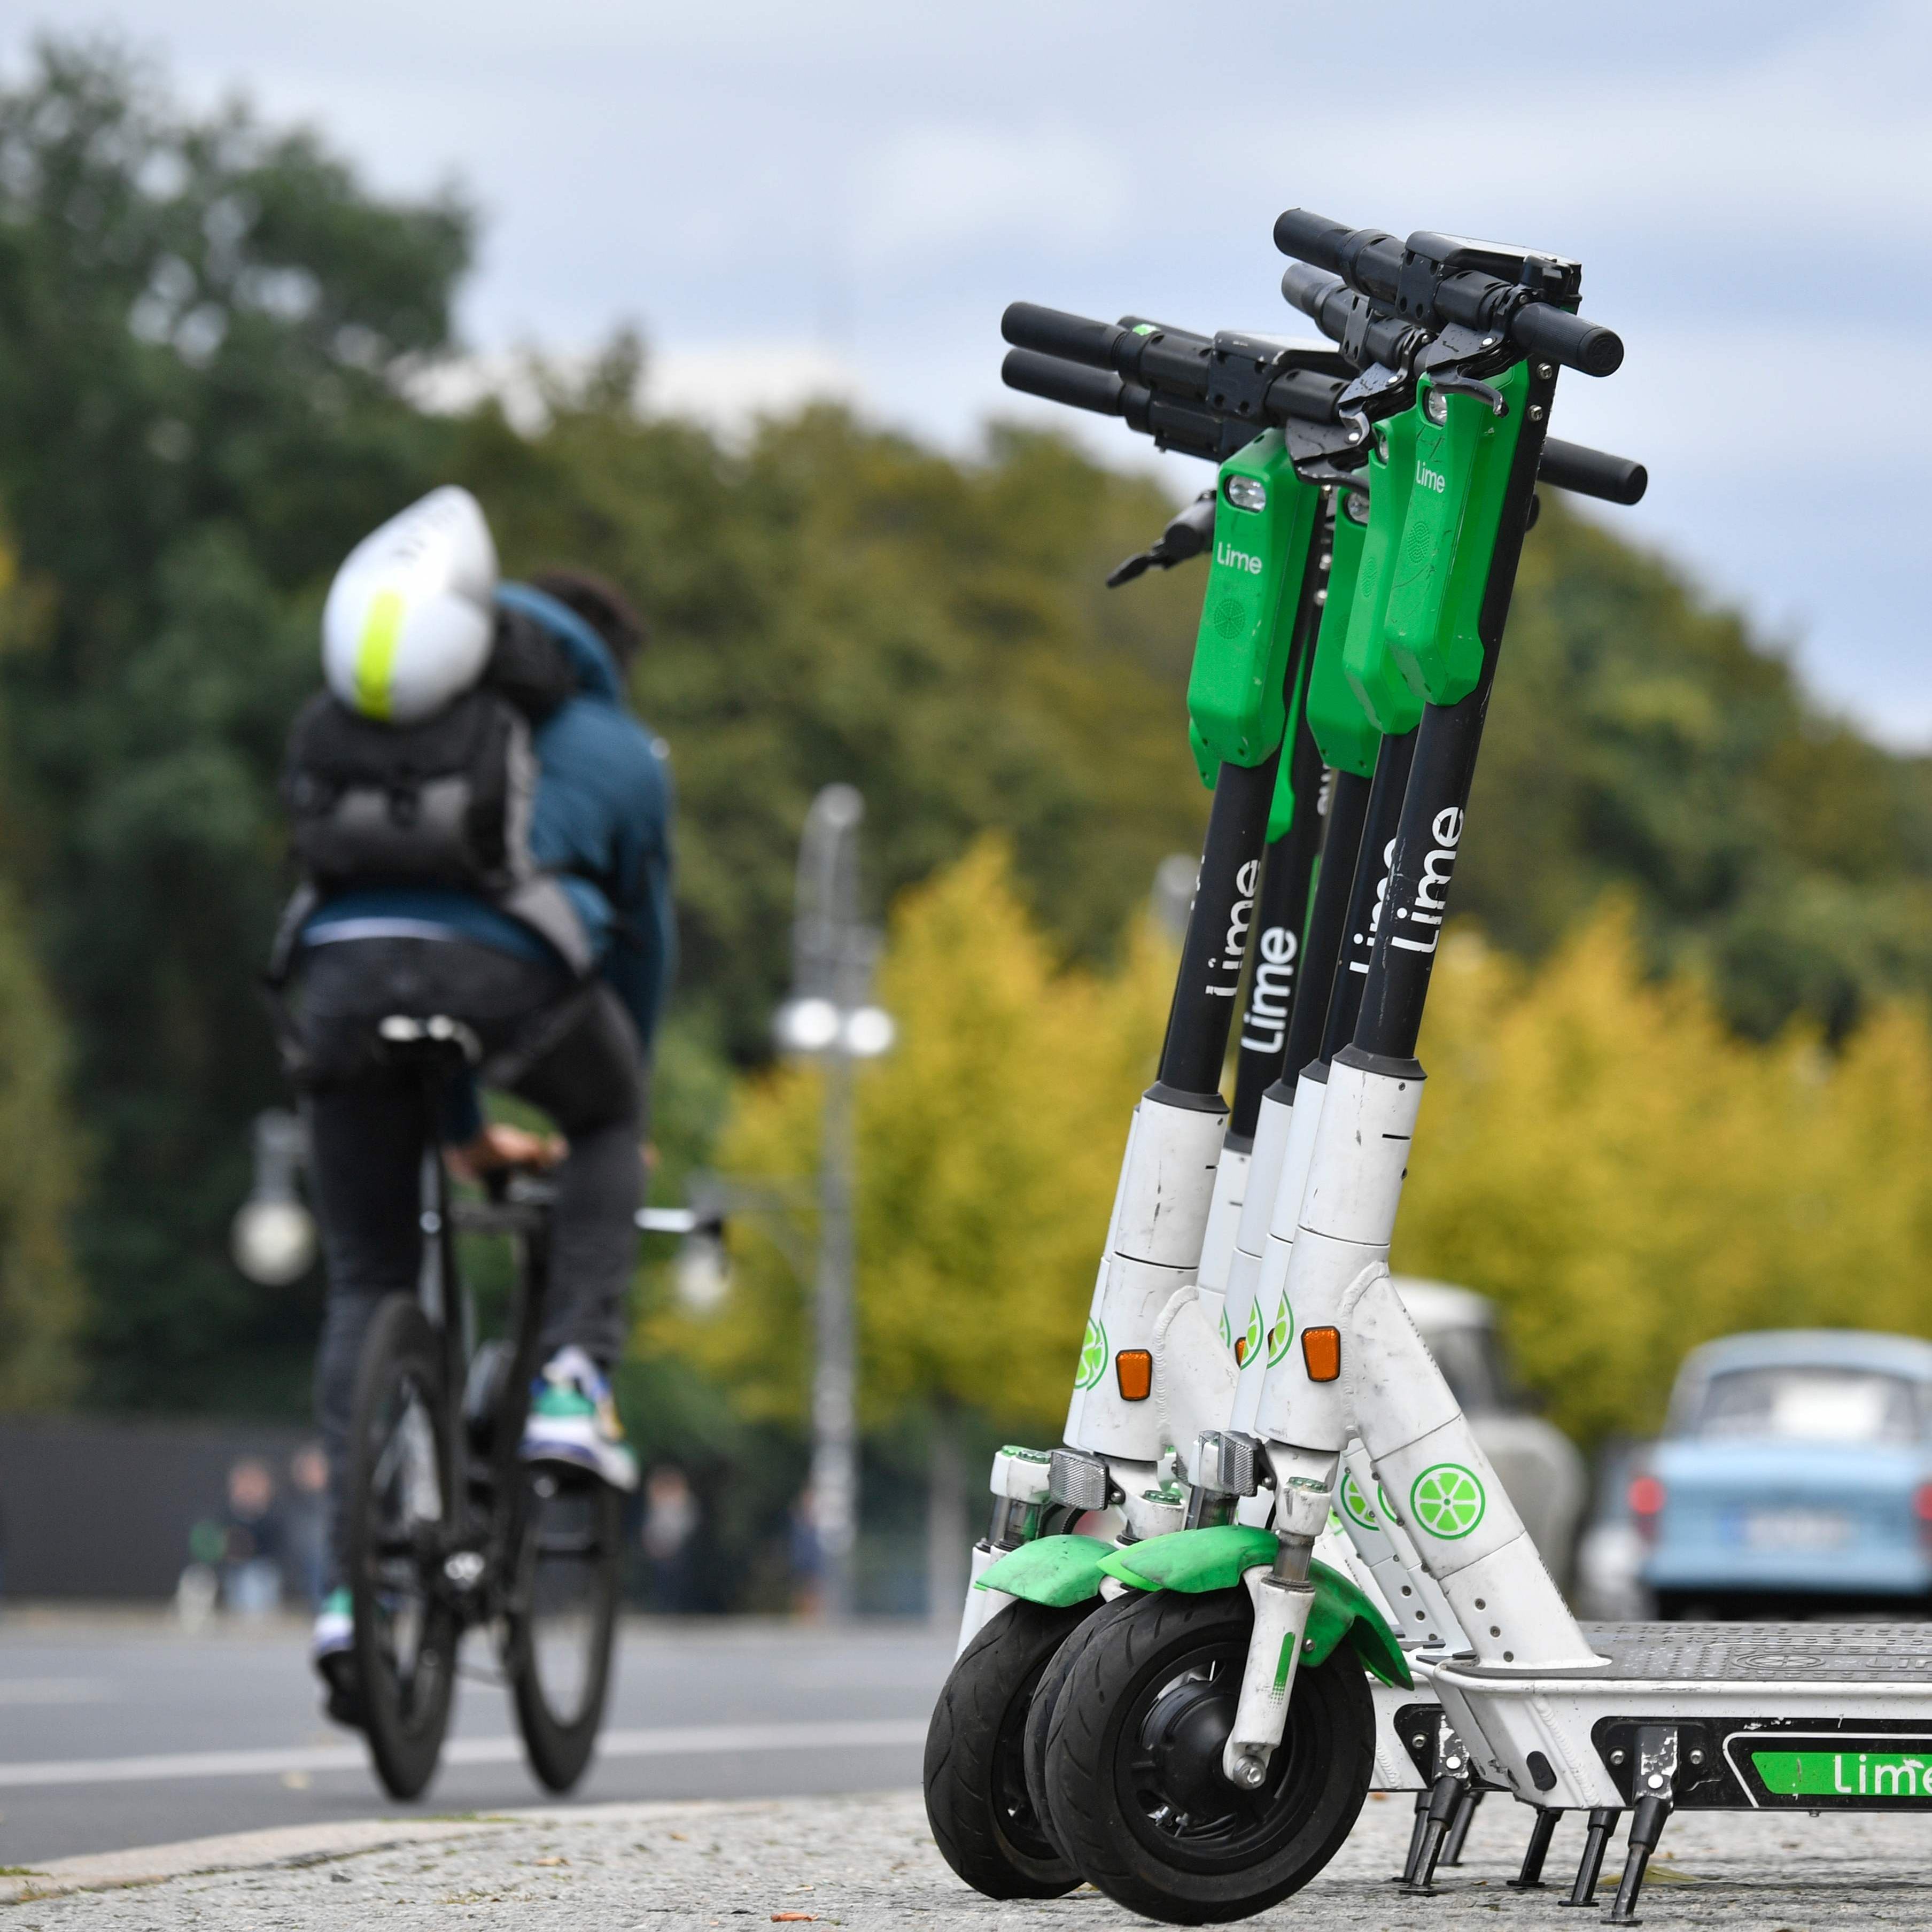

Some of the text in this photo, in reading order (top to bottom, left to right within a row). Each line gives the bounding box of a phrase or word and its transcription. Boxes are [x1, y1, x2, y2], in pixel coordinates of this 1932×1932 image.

[1416, 460, 1445, 493] Lime
[1217, 541, 1263, 575] Lime
[1391, 806, 1464, 953] Lime
[1240, 926, 1298, 1054] Lime
